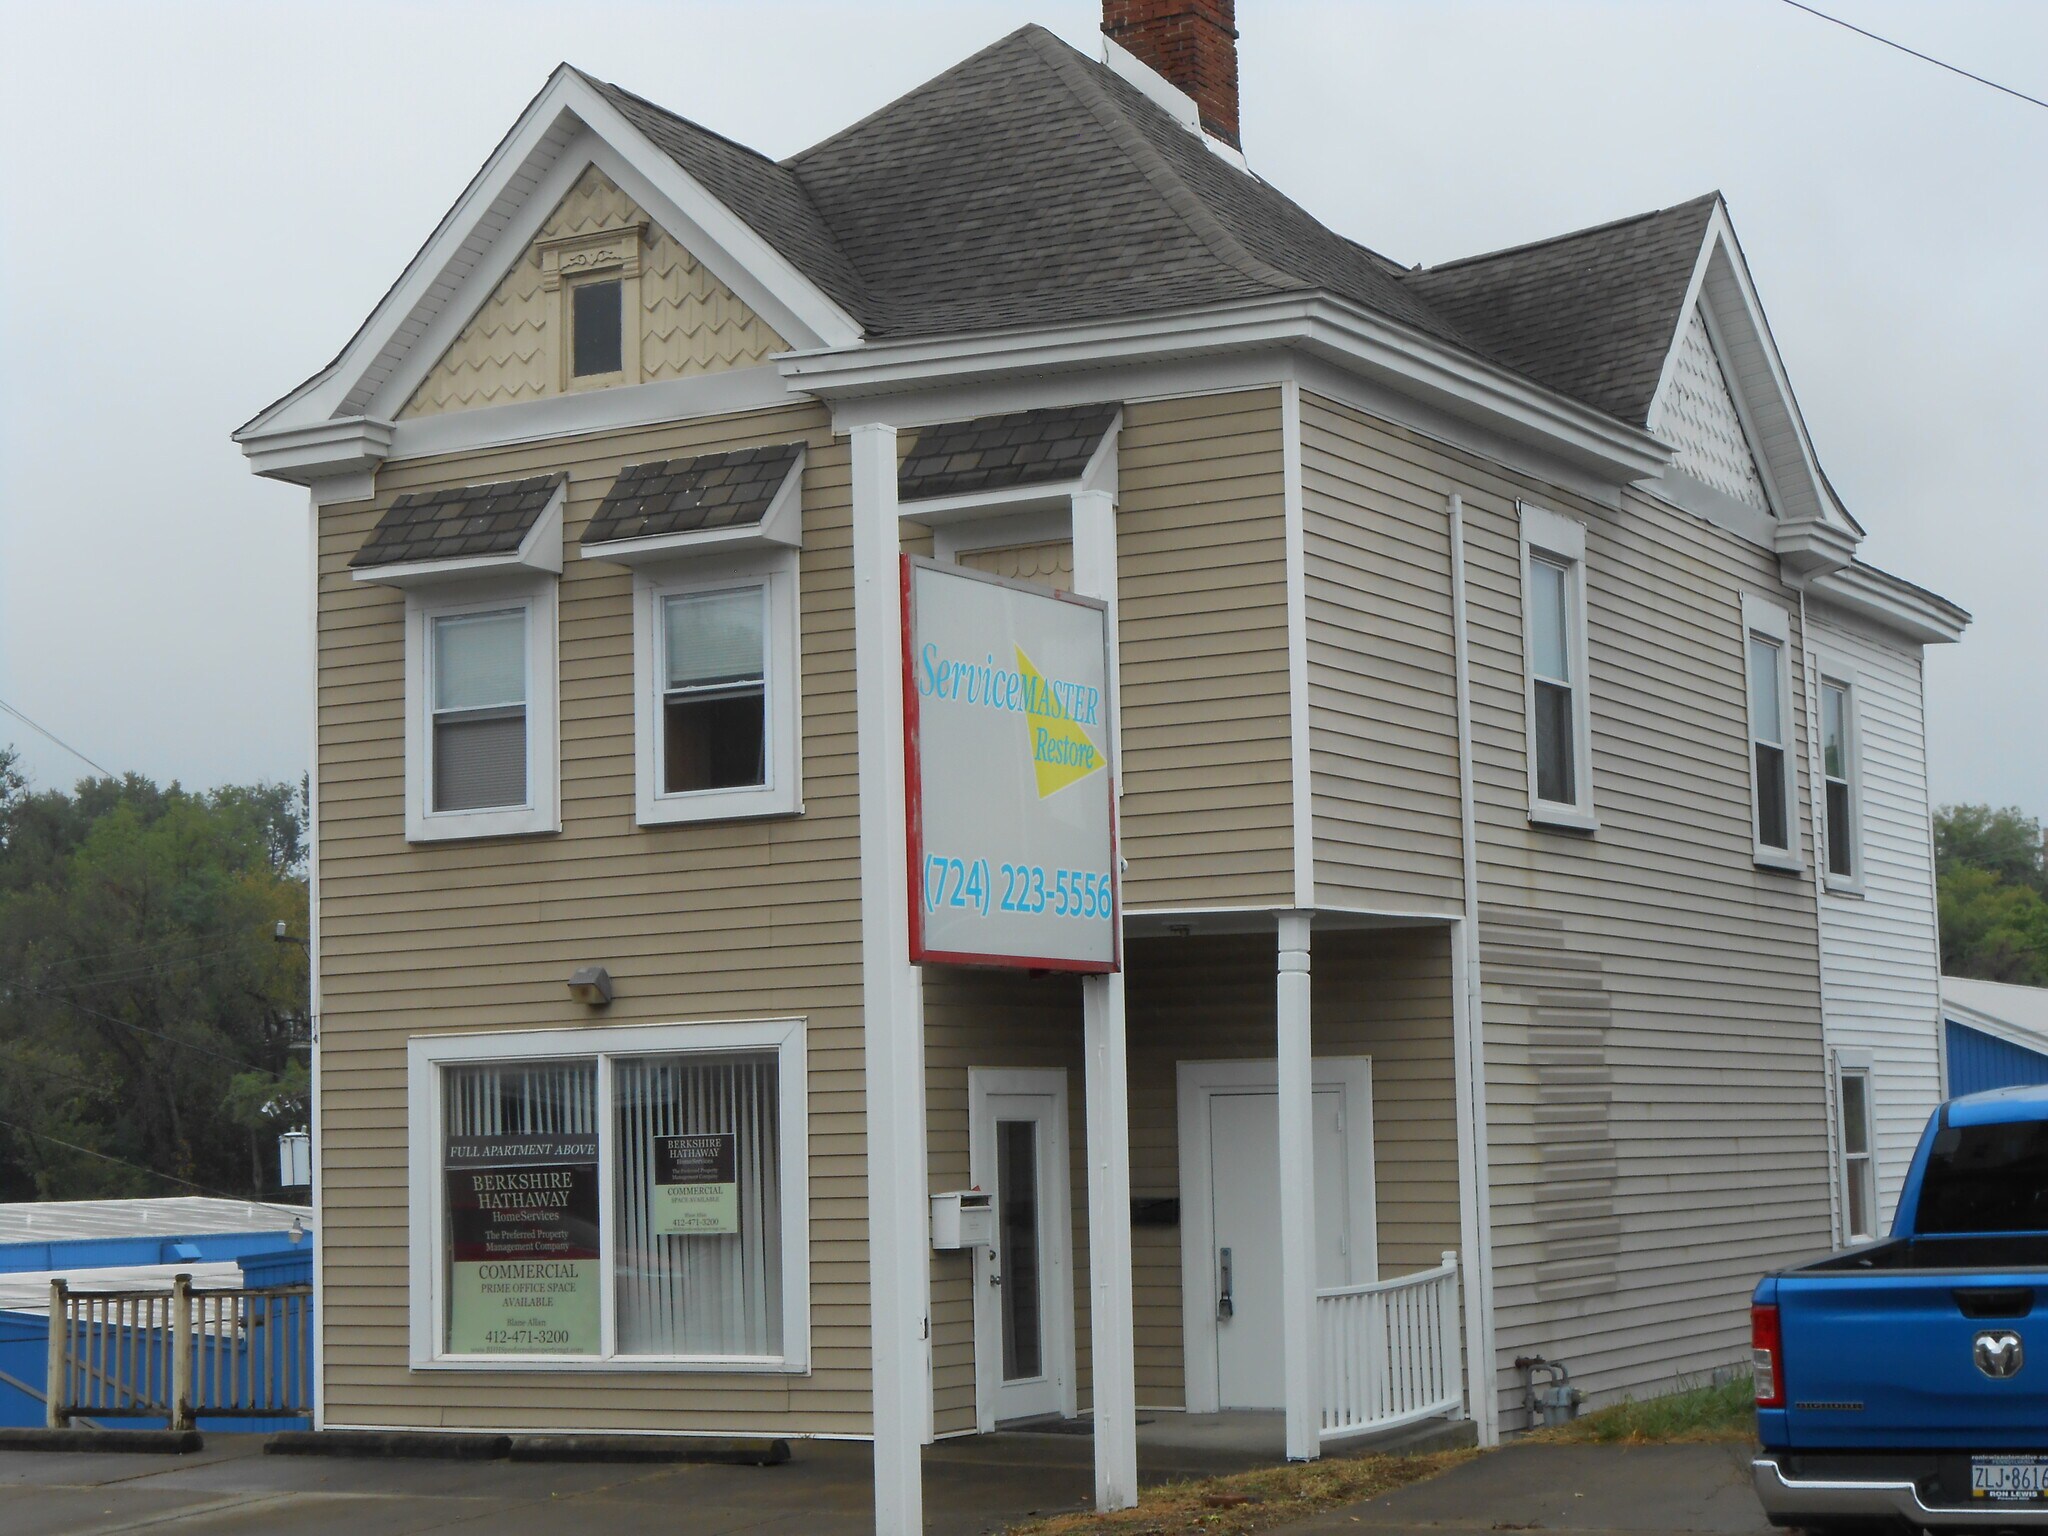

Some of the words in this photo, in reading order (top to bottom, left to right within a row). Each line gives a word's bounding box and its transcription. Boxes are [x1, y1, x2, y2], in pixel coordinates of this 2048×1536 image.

[919, 641, 1100, 726] ServiceMASTER
[1034, 727, 1095, 769] Restore
[924, 853, 991, 917] (724)
[1000, 863, 1112, 920] 223-5556
[668, 1139, 721, 1149] BERKSHIRE
[450, 1146, 480, 1157] FULL
[482, 1144, 553, 1156] APARTMENT
[554, 1144, 596, 1155] ABOVE
[670, 1148, 720, 1158] HATHAWAY
[472, 1172, 573, 1191] BERKSHIRE
[667, 1186, 723, 1195] COMMERCIAL
[478, 1191, 570, 1209] HATHAWAY
[492, 1211, 560, 1223] HomeServices
[485, 1230, 500, 1240] The
[501, 1229, 535, 1239] Preferred
[537, 1229, 569, 1240] Property
[486, 1242, 533, 1253] Management
[535, 1241, 569, 1252] Company
[479, 1264, 579, 1279] COMMERCIAL
[481, 1283, 511, 1293] PRIME
[512, 1283, 545, 1293] OFFICE
[547, 1282, 576, 1292] SPACE
[502, 1297, 553, 1307] AVAILABLE
[485, 1330, 569, 1344] 412-471-3200
